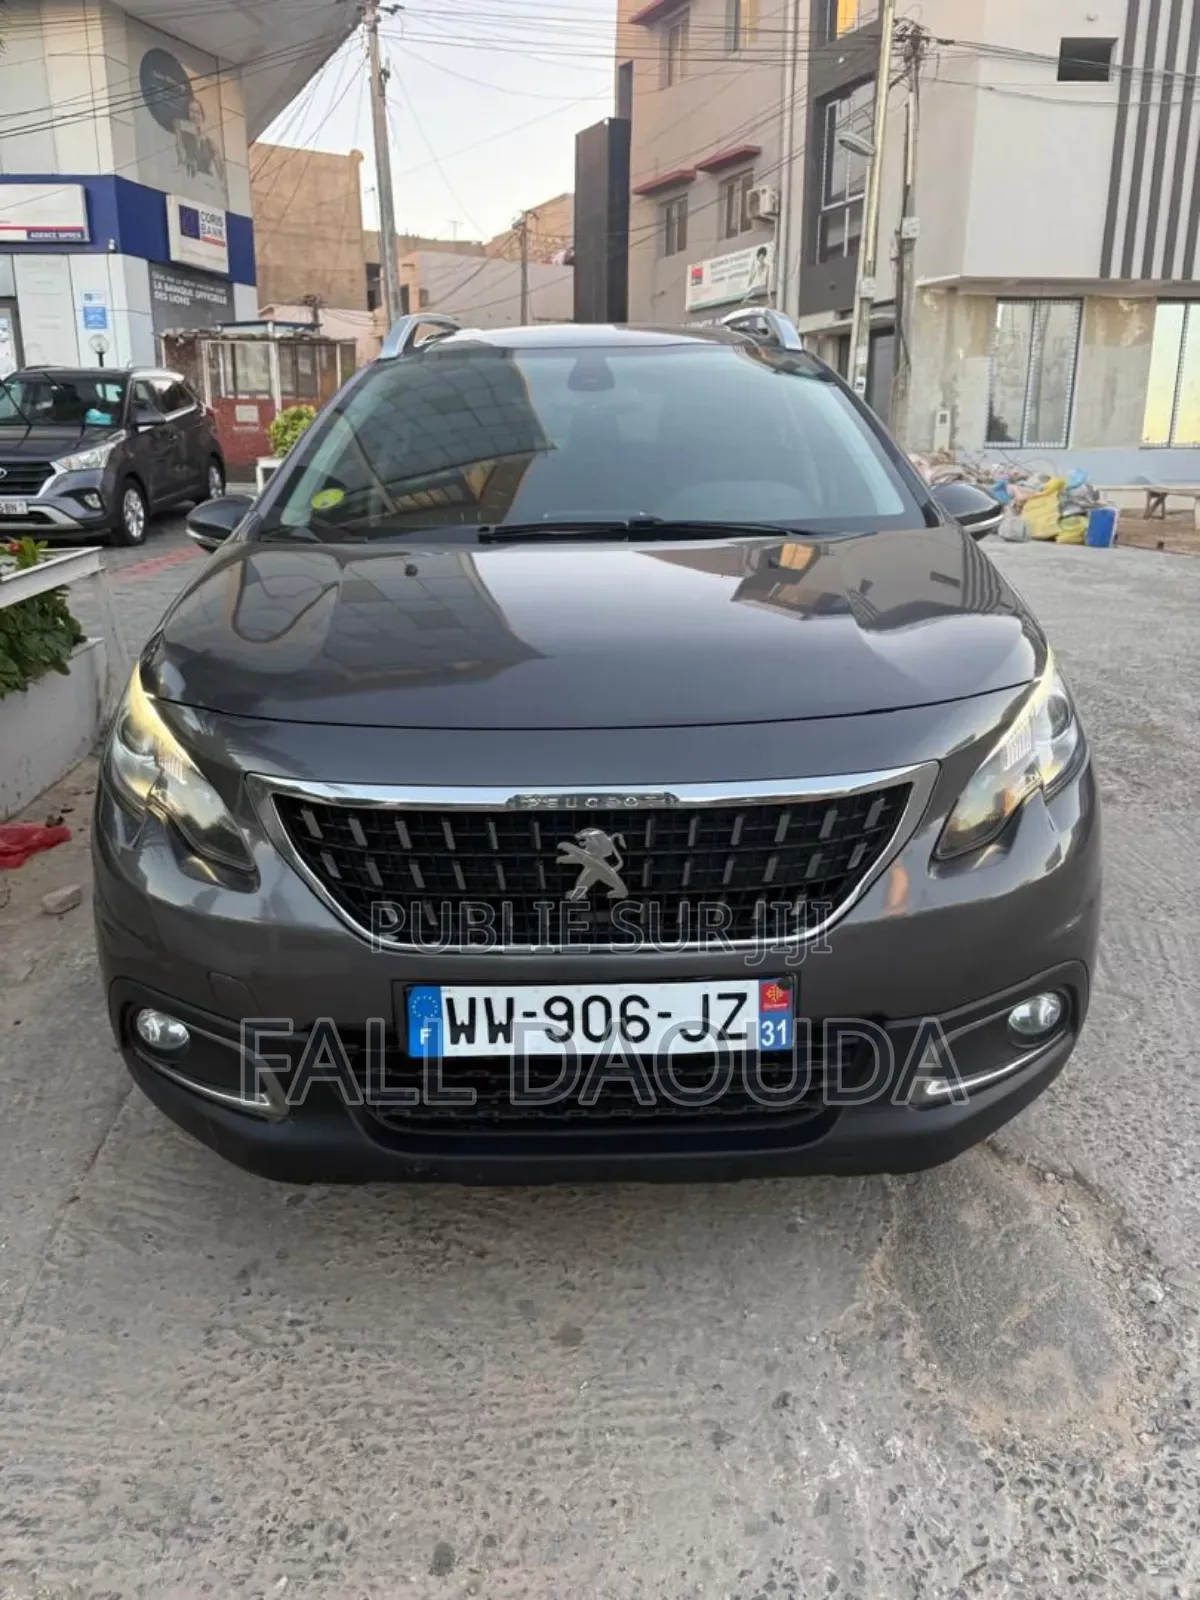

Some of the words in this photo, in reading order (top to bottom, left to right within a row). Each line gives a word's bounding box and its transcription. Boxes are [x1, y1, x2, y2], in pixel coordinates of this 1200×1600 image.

[200, 211, 224, 228] CORIS
[201, 223, 224, 237] BANK
[153, 280, 163, 290] LA
[164, 283, 194, 296] BANQUE
[154, 290, 168, 301] DES
[419, 1028, 432, 1045] F
[761, 1019, 787, 1047] 31
